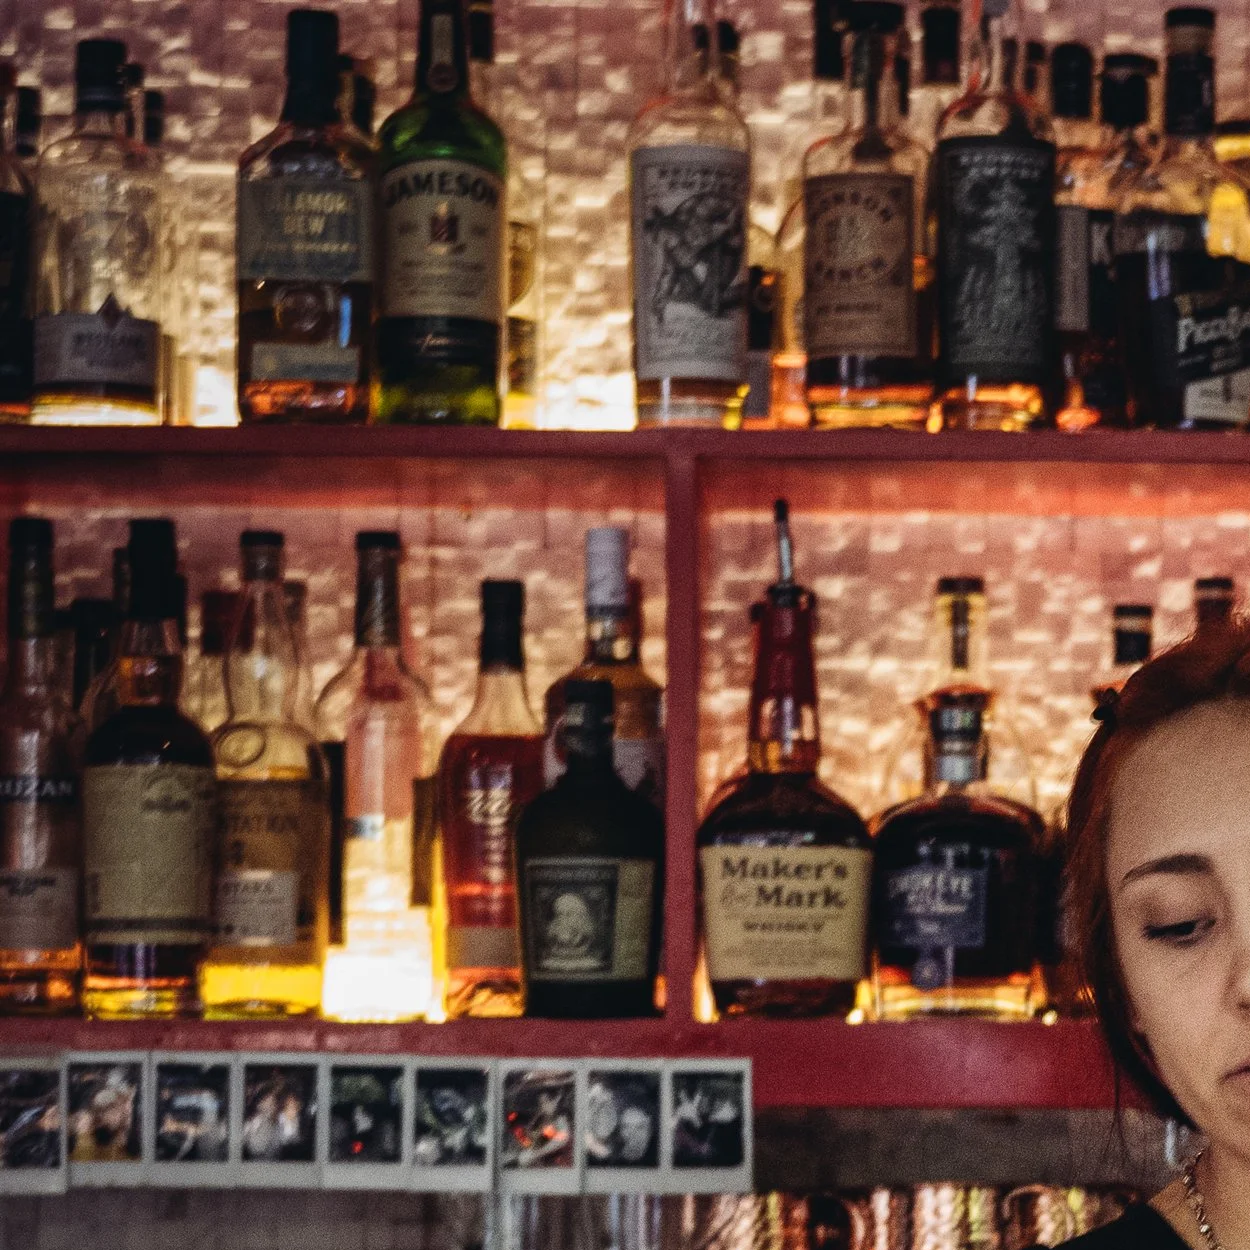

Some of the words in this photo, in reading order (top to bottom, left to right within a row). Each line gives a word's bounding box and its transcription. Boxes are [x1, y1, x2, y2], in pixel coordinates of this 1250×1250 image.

[385, 169, 498, 208] JAMESON
[720, 855, 850, 881] Maker's
[758, 883, 848, 909] Mark
